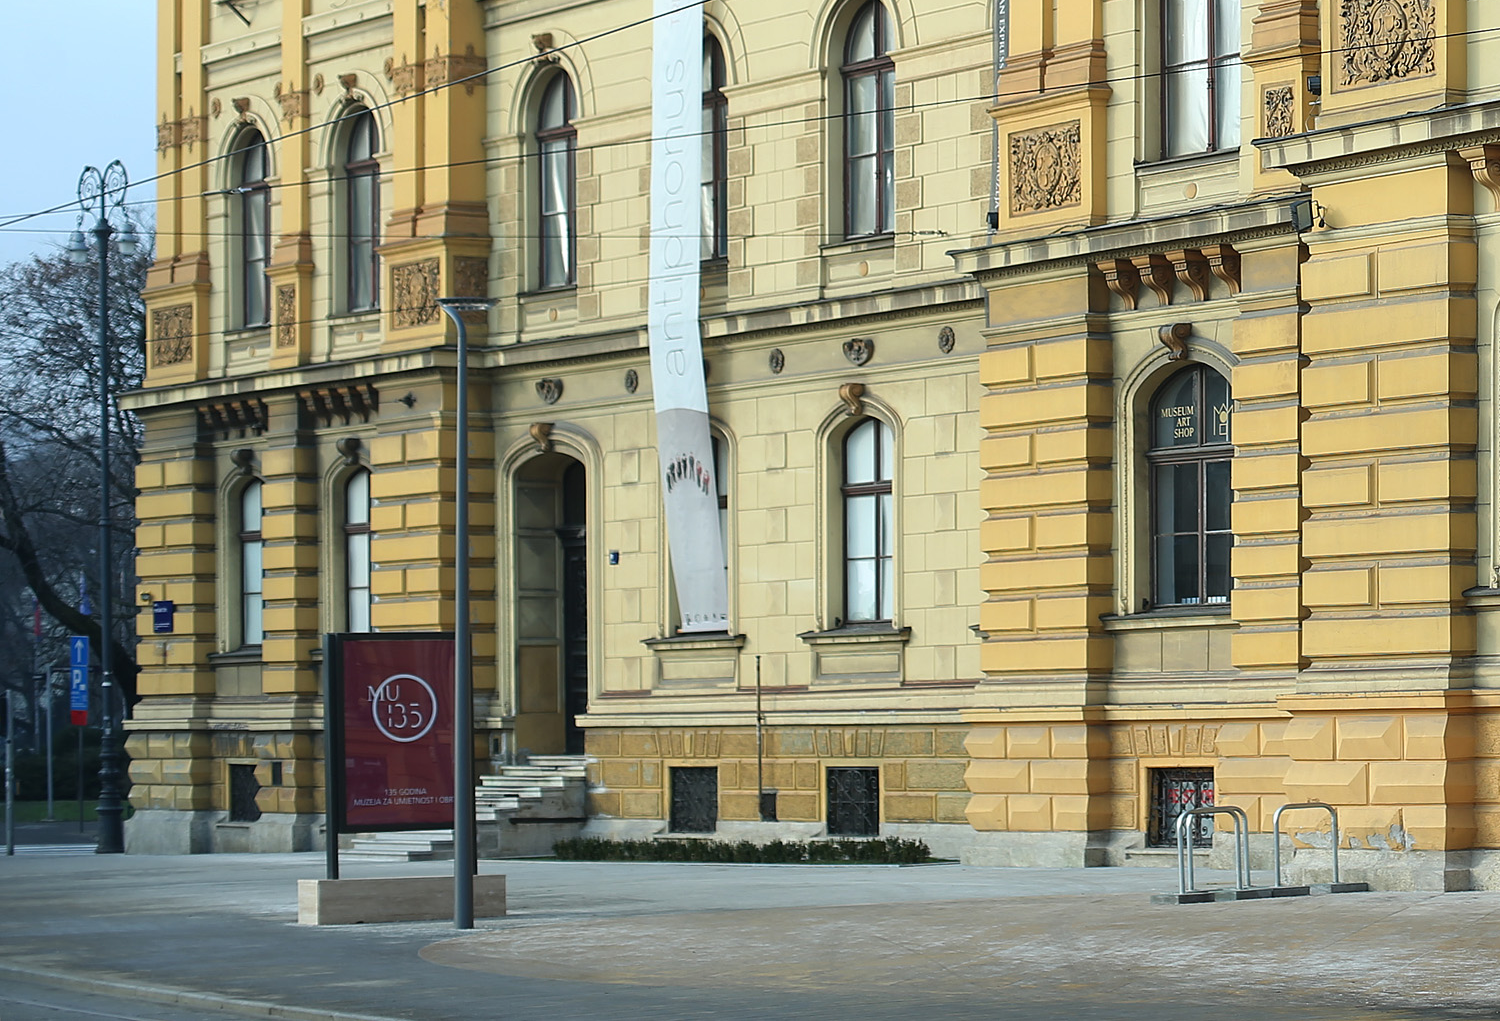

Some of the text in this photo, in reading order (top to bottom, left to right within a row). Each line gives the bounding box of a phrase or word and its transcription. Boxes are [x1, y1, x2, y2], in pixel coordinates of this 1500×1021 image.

[1161, 406, 1194, 418] MUSEUM
[1176, 417, 1191, 427] ART
[1174, 427, 1195, 439] SHOP
[367, 685, 400, 701] MU
[398, 788, 427, 796] GODINA
[353, 798, 381, 807] MUZEJA
[382, 798, 392, 806] ZA
[394, 796, 433, 805] UMJETNOST
[439, 796, 454, 804] OBR
